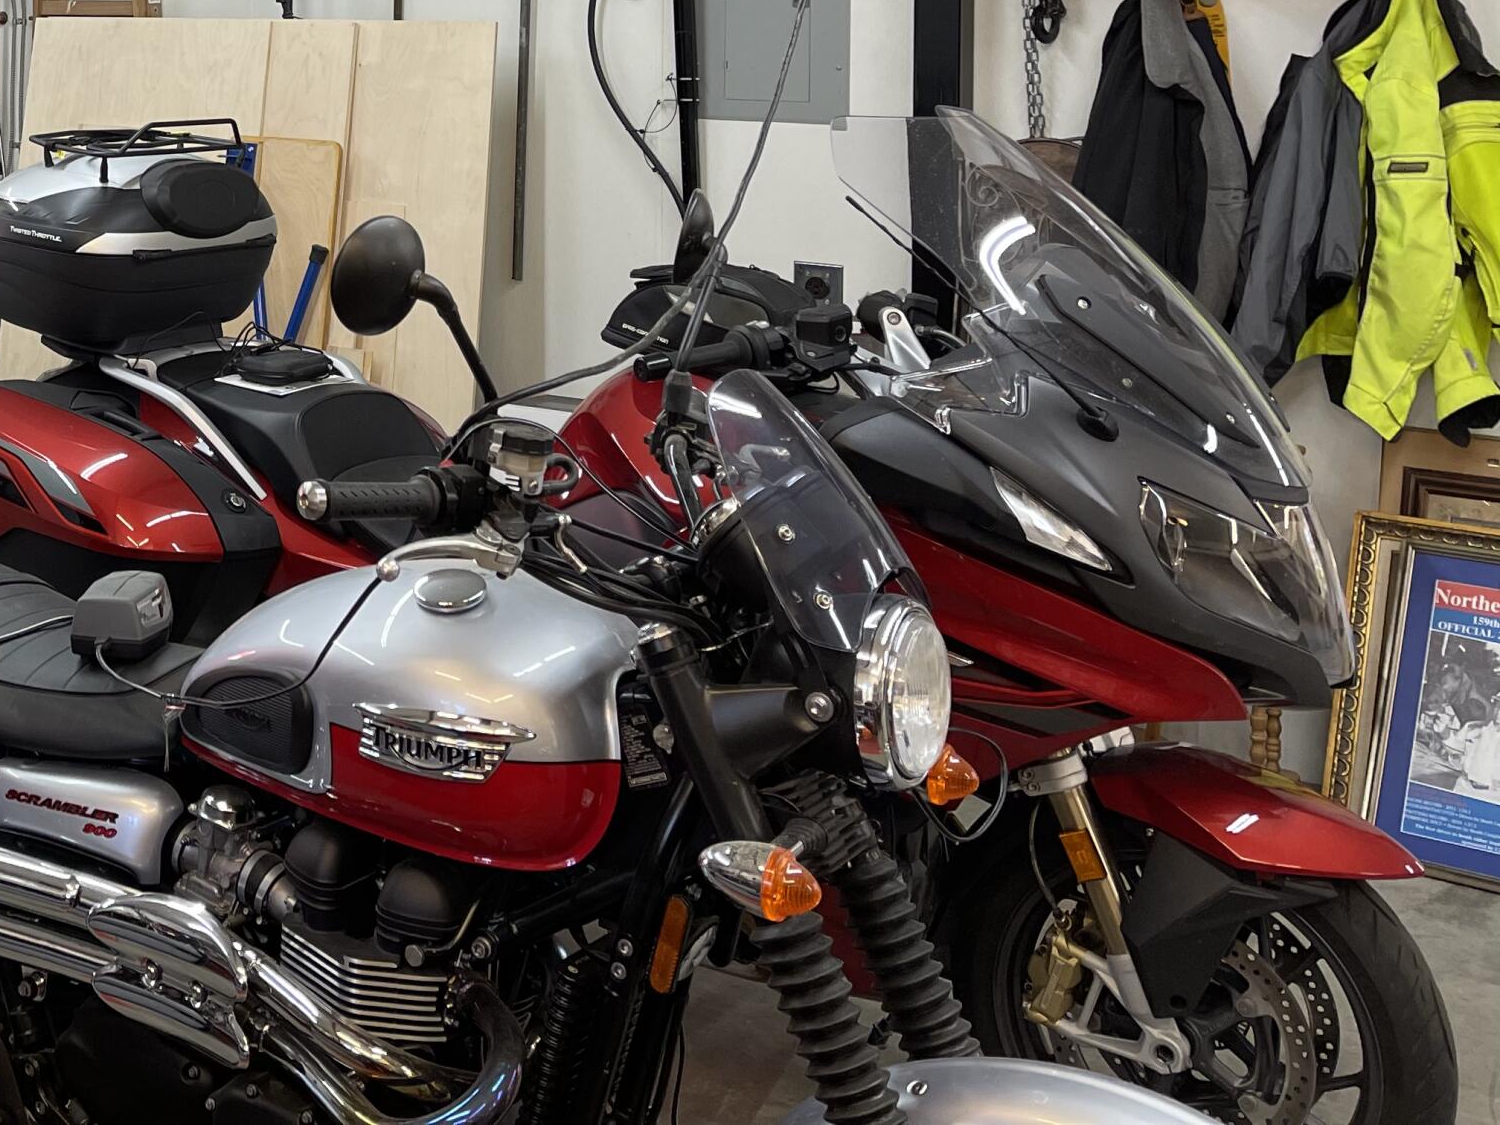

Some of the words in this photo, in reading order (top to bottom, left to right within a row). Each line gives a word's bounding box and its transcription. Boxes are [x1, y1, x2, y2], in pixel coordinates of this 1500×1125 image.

[1438, 621, 1493, 638] OFFICIAL
[1473, 615, 1500, 628] 159th
[371, 724, 483, 770] TRIUMPH
[5, 788, 119, 824] SCRAMBLER
[82, 823, 118, 838] 900
